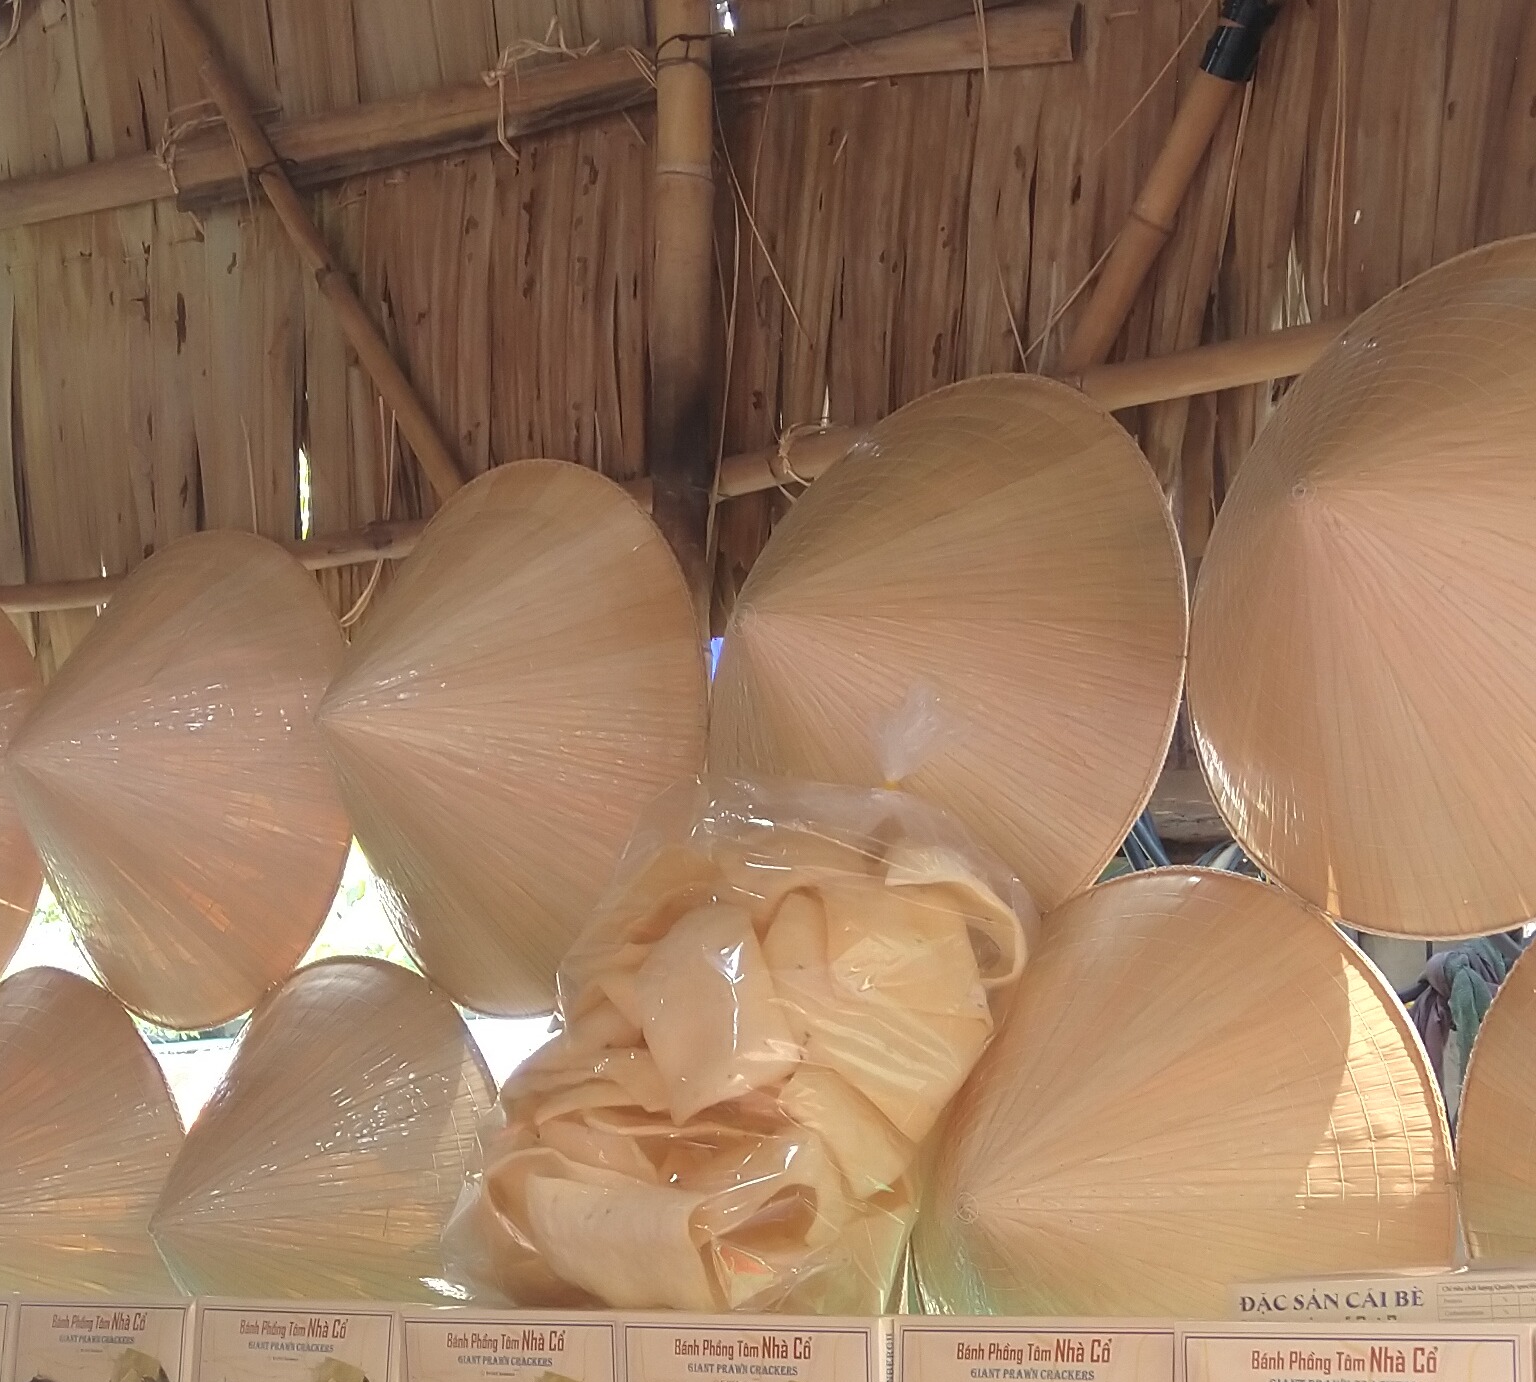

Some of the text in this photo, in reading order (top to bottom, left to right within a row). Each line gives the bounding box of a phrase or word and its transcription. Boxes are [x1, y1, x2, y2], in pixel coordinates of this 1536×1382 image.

[447, 1332, 468, 1349] Bánh
[521, 1329, 544, 1352] Nhà
[674, 1338, 699, 1356] Bánh
[761, 1335, 788, 1360] Nhà
[957, 1337, 1111, 1365] Bánh Phồng Tôm Nhà Cổ
[1251, 1345, 1438, 1376] Bánh Phồng Tôm Nhà Cổ
[970, 1368, 1095, 1381] GIANT PRAWN CRACKERS
